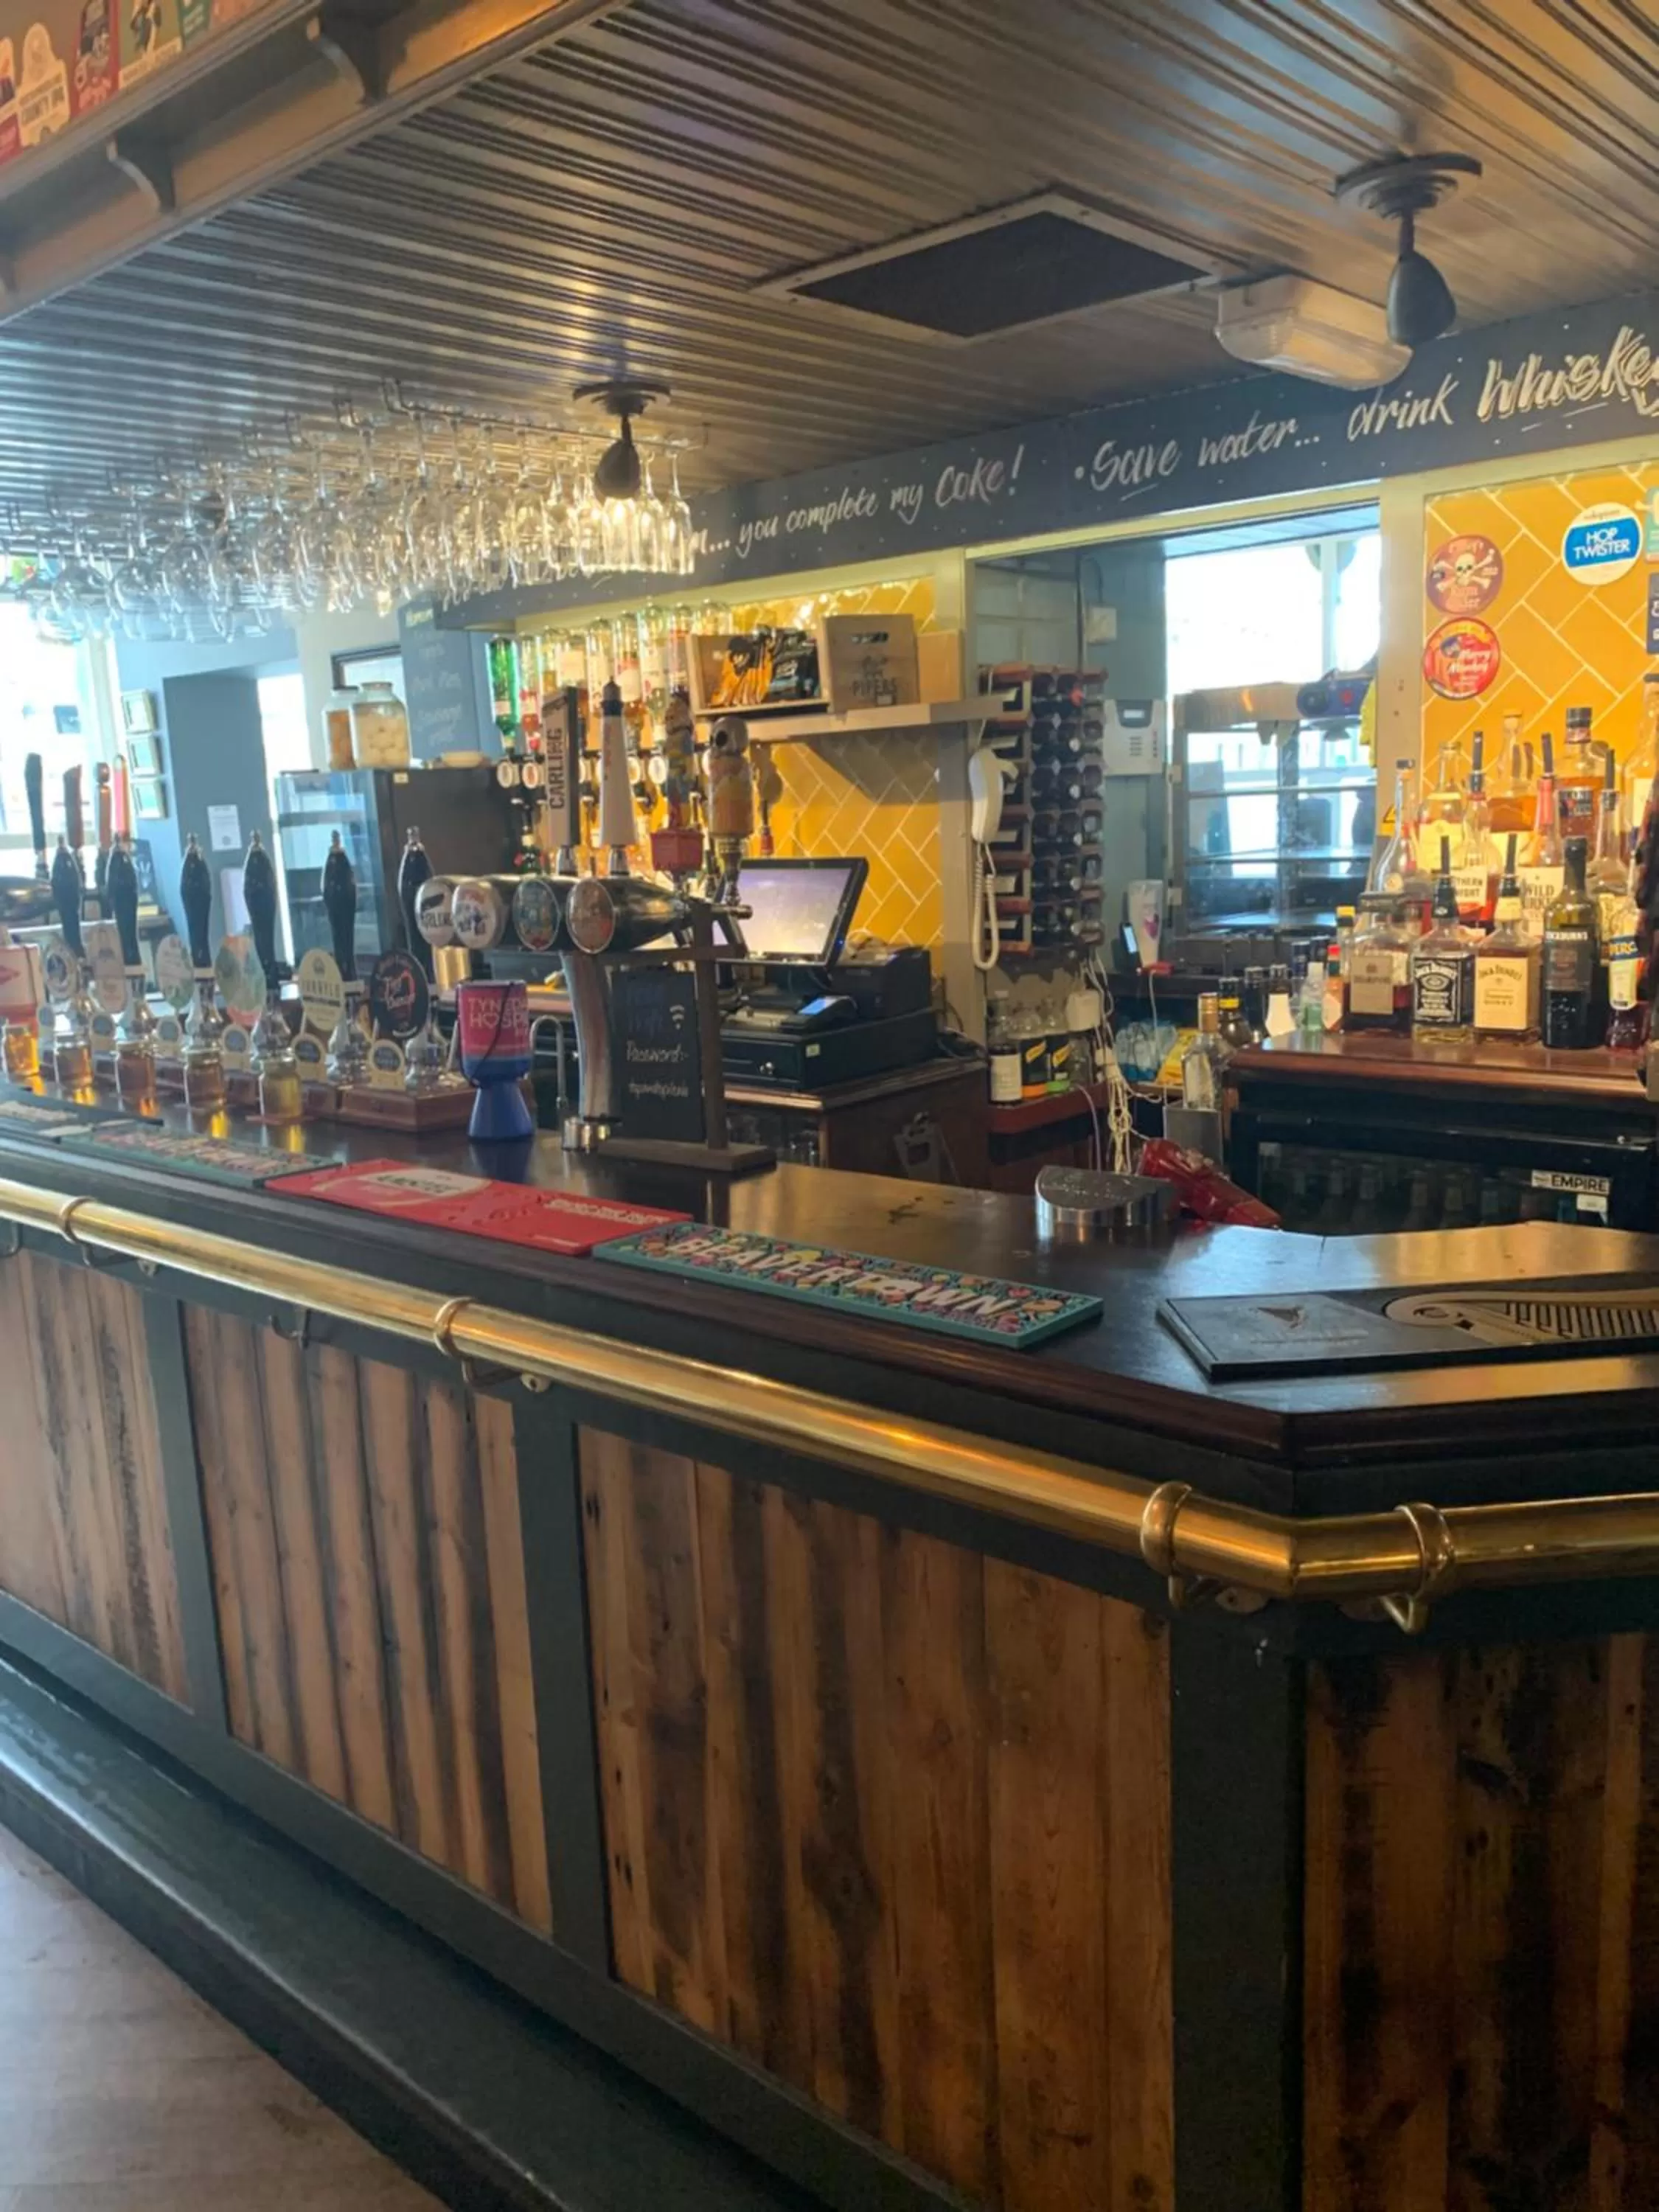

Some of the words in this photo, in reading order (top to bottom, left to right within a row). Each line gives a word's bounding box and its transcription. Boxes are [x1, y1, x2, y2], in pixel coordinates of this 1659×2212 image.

[1090, 440, 1178, 491] Save
[1347, 372, 1458, 442] drink
[739, 516, 778, 558] you
[785, 487, 878, 534] complete
[889, 483, 923, 525] my
[1573, 538, 1632, 560] TWISTER
[1585, 526, 1619, 543] HOP
[547, 727, 565, 810] CARLING
[1551, 1174, 1607, 1192] EMPIRE
[666, 1237, 1020, 1315] BEAVERTOWN
